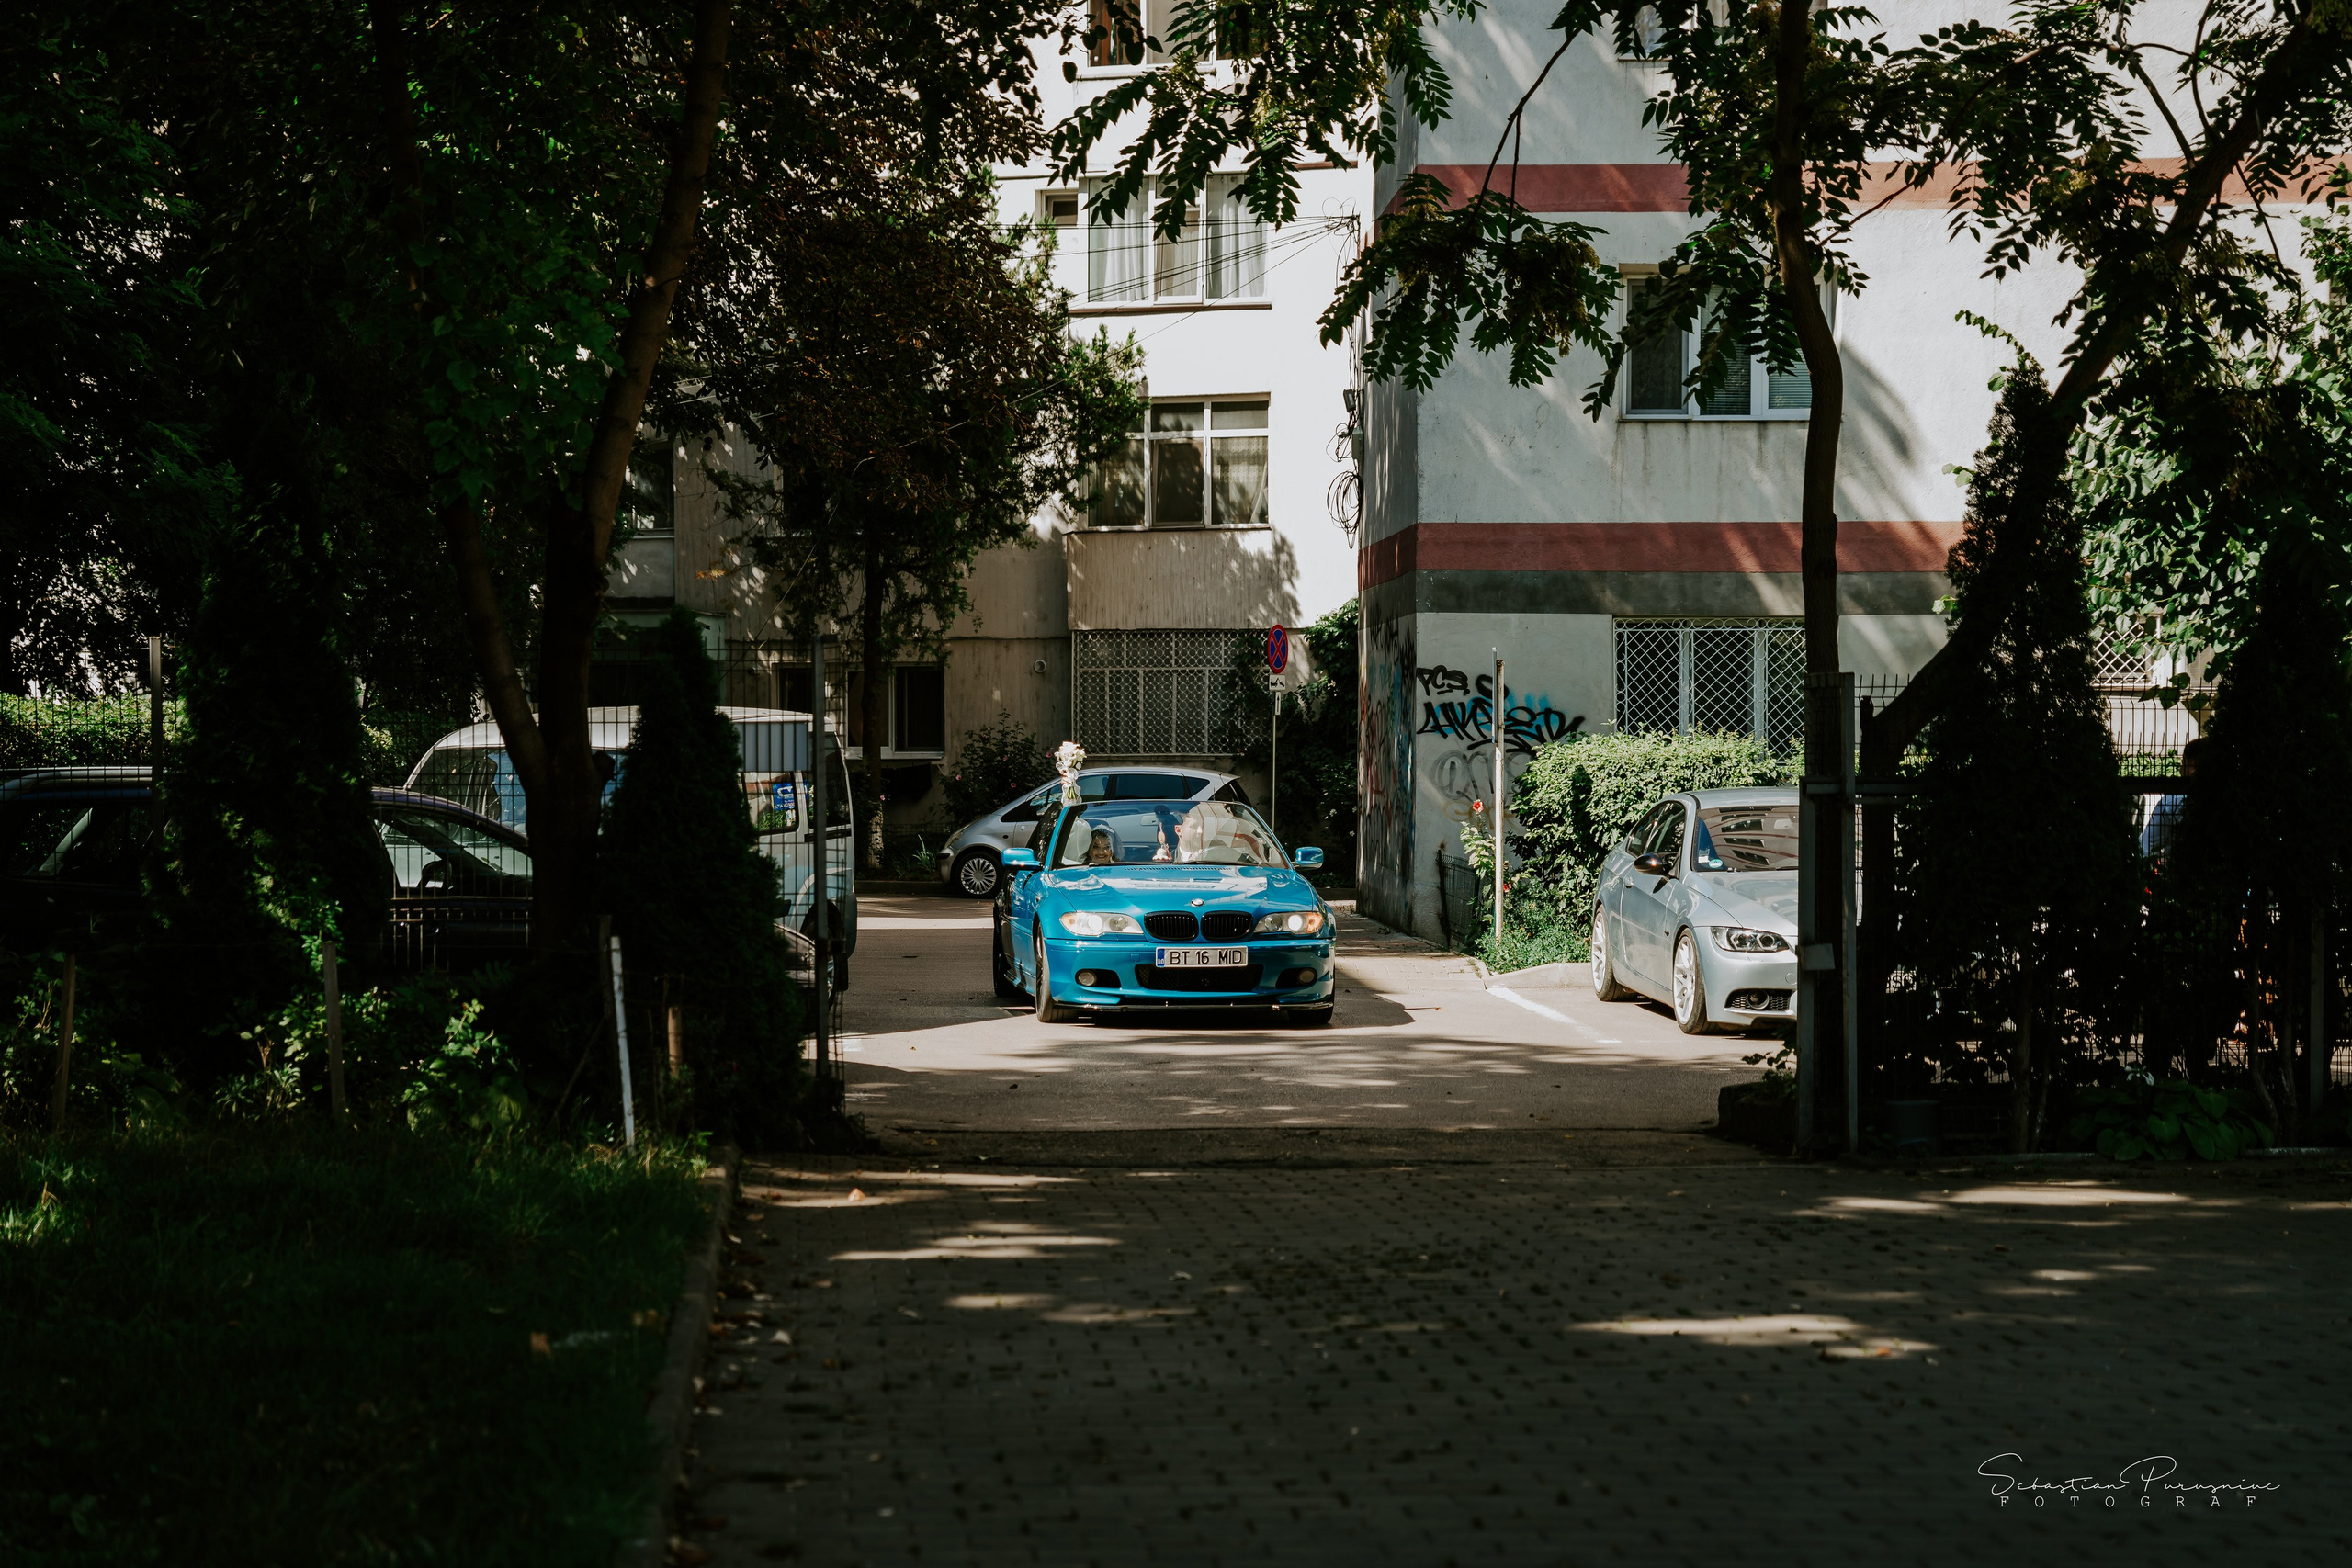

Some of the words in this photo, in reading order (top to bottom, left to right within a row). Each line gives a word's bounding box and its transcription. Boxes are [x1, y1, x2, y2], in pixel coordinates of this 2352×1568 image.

[1170, 951, 1190, 965] BT
[1196, 951, 1210, 965] 16
[1218, 950, 1242, 965] MID
